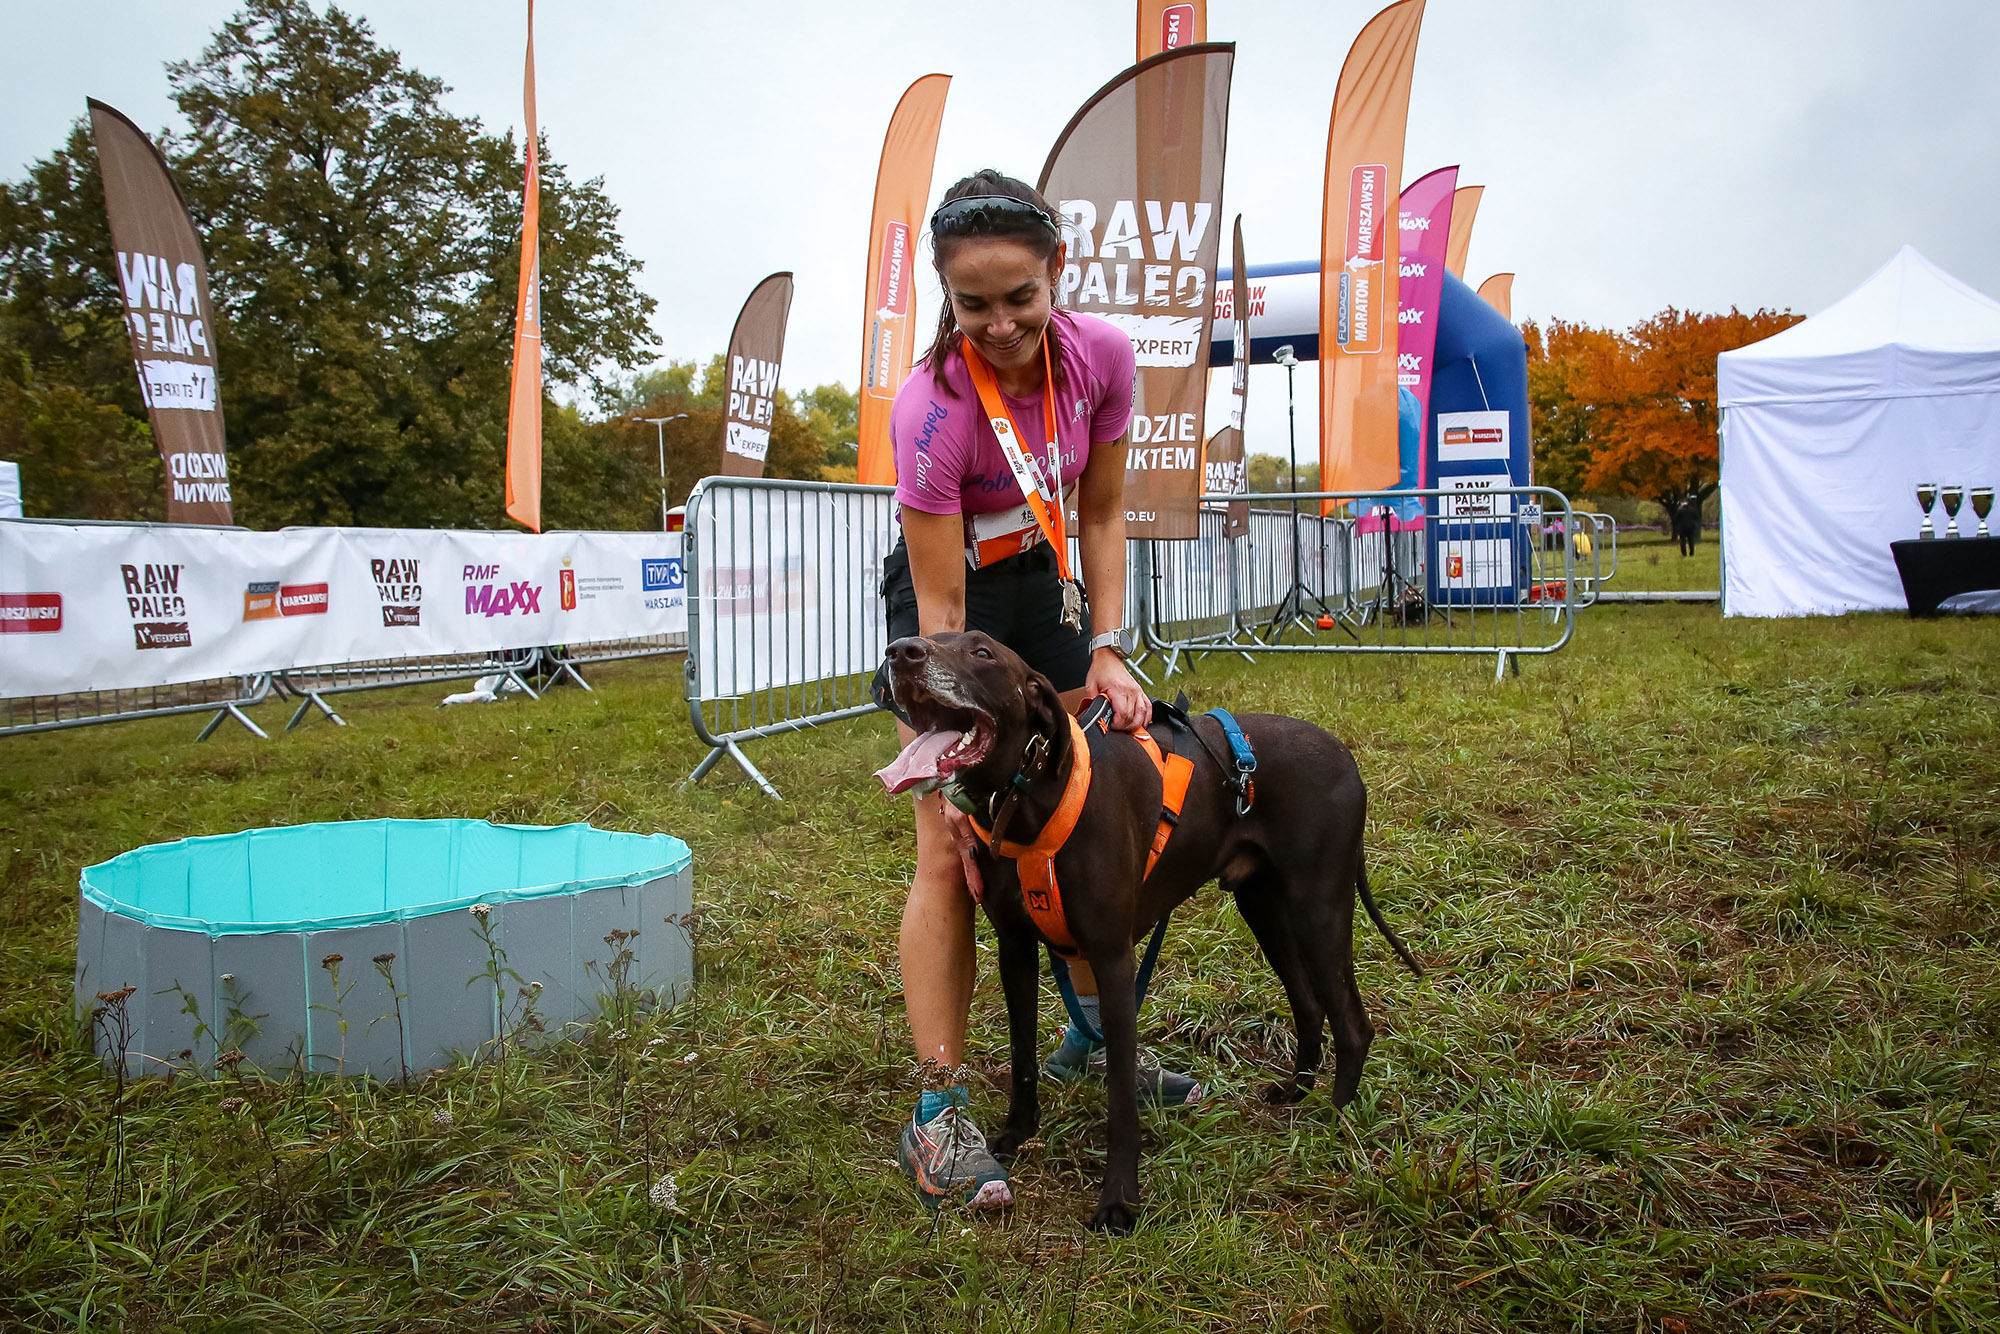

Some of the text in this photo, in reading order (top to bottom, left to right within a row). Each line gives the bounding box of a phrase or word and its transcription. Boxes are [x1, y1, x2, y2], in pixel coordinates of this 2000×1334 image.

[1167, 14, 1181, 50] SKI
[1058, 199, 1212, 262] RAW
[1355, 169, 1375, 342] MARATON WARSZAWSKI
[1058, 261, 1207, 308] PALEO
[879, 226, 906, 389] MARATON WARSZAWSKI
[1338, 275, 1347, 341] FUNDACJA
[731, 354, 780, 399] RAW
[1128, 412, 1197, 443] DZIE
[1205, 478, 1230, 492] PALE
[120, 564, 180, 594] RAW
[370, 558, 419, 584] RAW
[462, 564, 501, 582] RMF
[127, 596, 186, 618] PALEO
[376, 584, 422, 602] PALEO
[465, 580, 543, 618] MAXX
[644, 597, 684, 610] WARSZAWA
